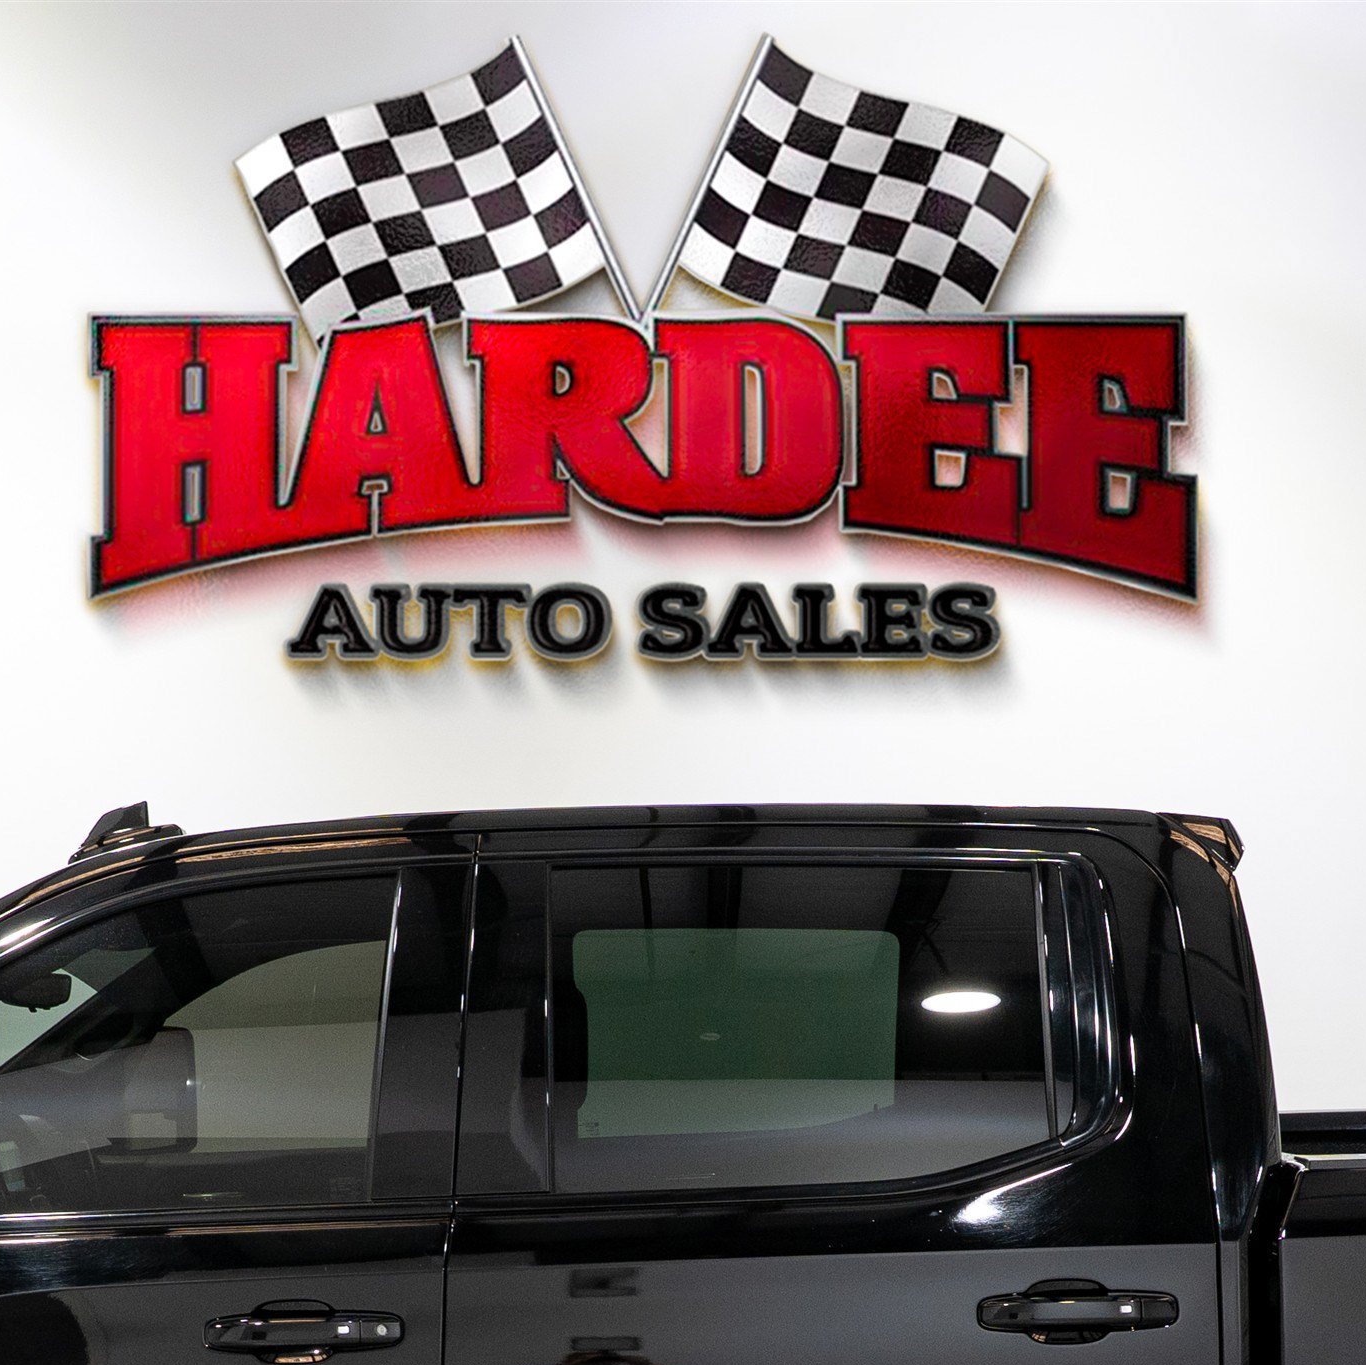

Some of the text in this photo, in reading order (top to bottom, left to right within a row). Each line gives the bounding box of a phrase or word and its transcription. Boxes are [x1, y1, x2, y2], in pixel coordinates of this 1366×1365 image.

[88, 311, 1198, 601] HARDEE
[289, 583, 1002, 661] AUTO SALES
